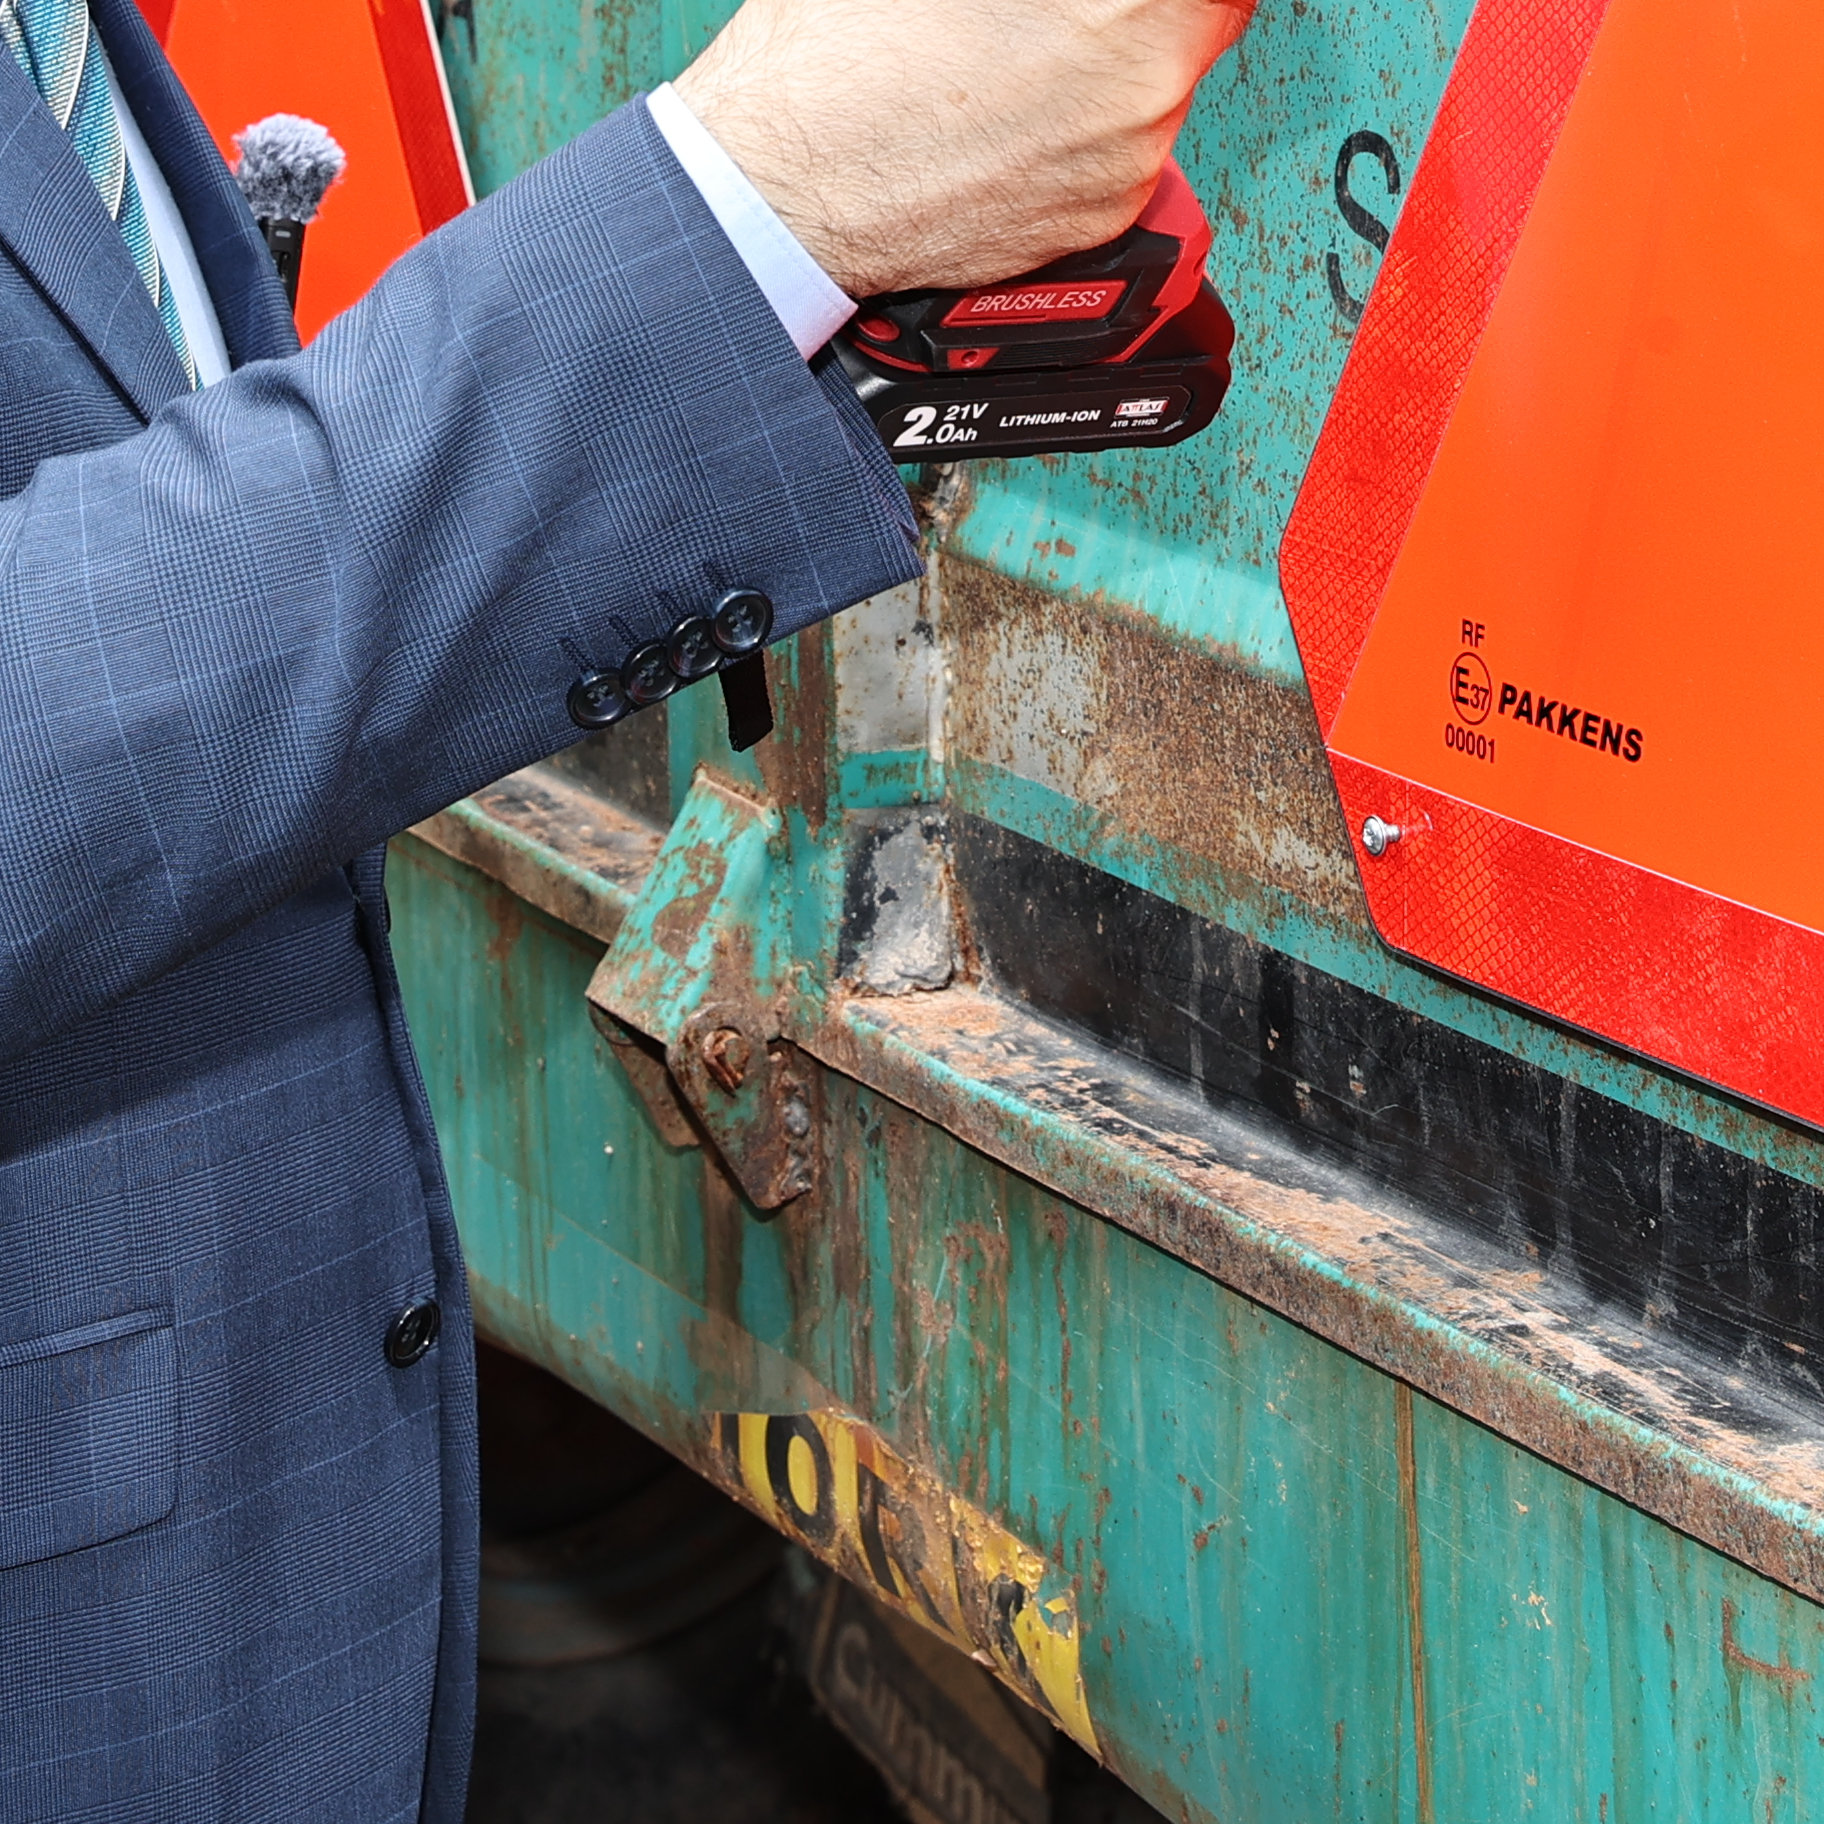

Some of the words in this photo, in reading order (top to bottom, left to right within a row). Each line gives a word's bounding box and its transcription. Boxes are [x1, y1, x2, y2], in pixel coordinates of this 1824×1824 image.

[970, 289, 1107, 313] BRUSHLESS
[943, 402, 990, 422] 21V
[999, 409, 1101, 428] LITHIUM-ION
[1461, 617, 1486, 649] RF
[1497, 681, 1644, 764] PAKKENS
[1444, 721, 1496, 765] 00001
